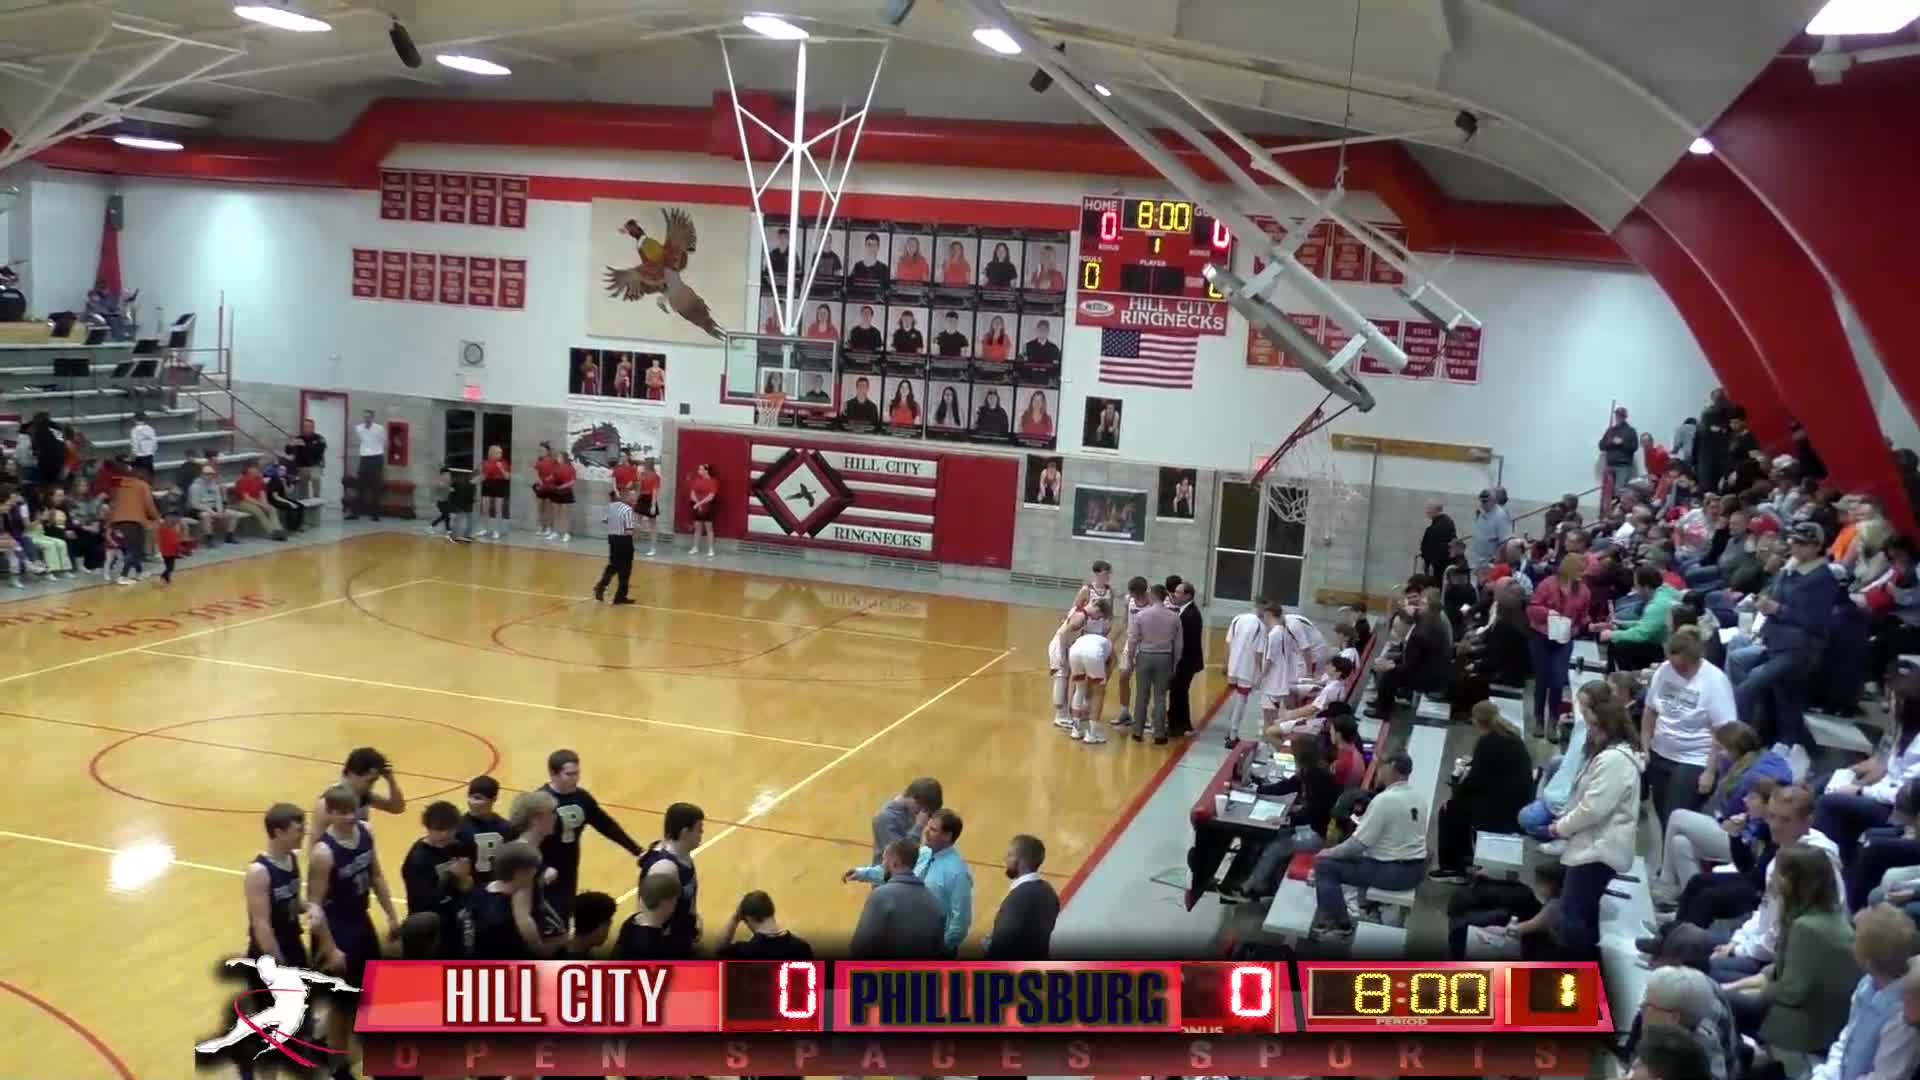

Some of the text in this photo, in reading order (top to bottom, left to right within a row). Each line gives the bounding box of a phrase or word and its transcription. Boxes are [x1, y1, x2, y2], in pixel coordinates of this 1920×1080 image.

[1085, 199, 1117, 211] HOME
[1138, 201, 1190, 230] 8:00
[1101, 212, 1117, 240] 0
[1154, 238, 1161, 254] 1
[1085, 263, 1100, 289] 0
[1129, 297, 1216, 315] HILL CITY
[1120, 310, 1224, 330] RINGNECKS
[844, 456, 921, 475] HILL CITY
[834, 526, 922, 547] RINGNECKS
[556, 804, 587, 843] P
